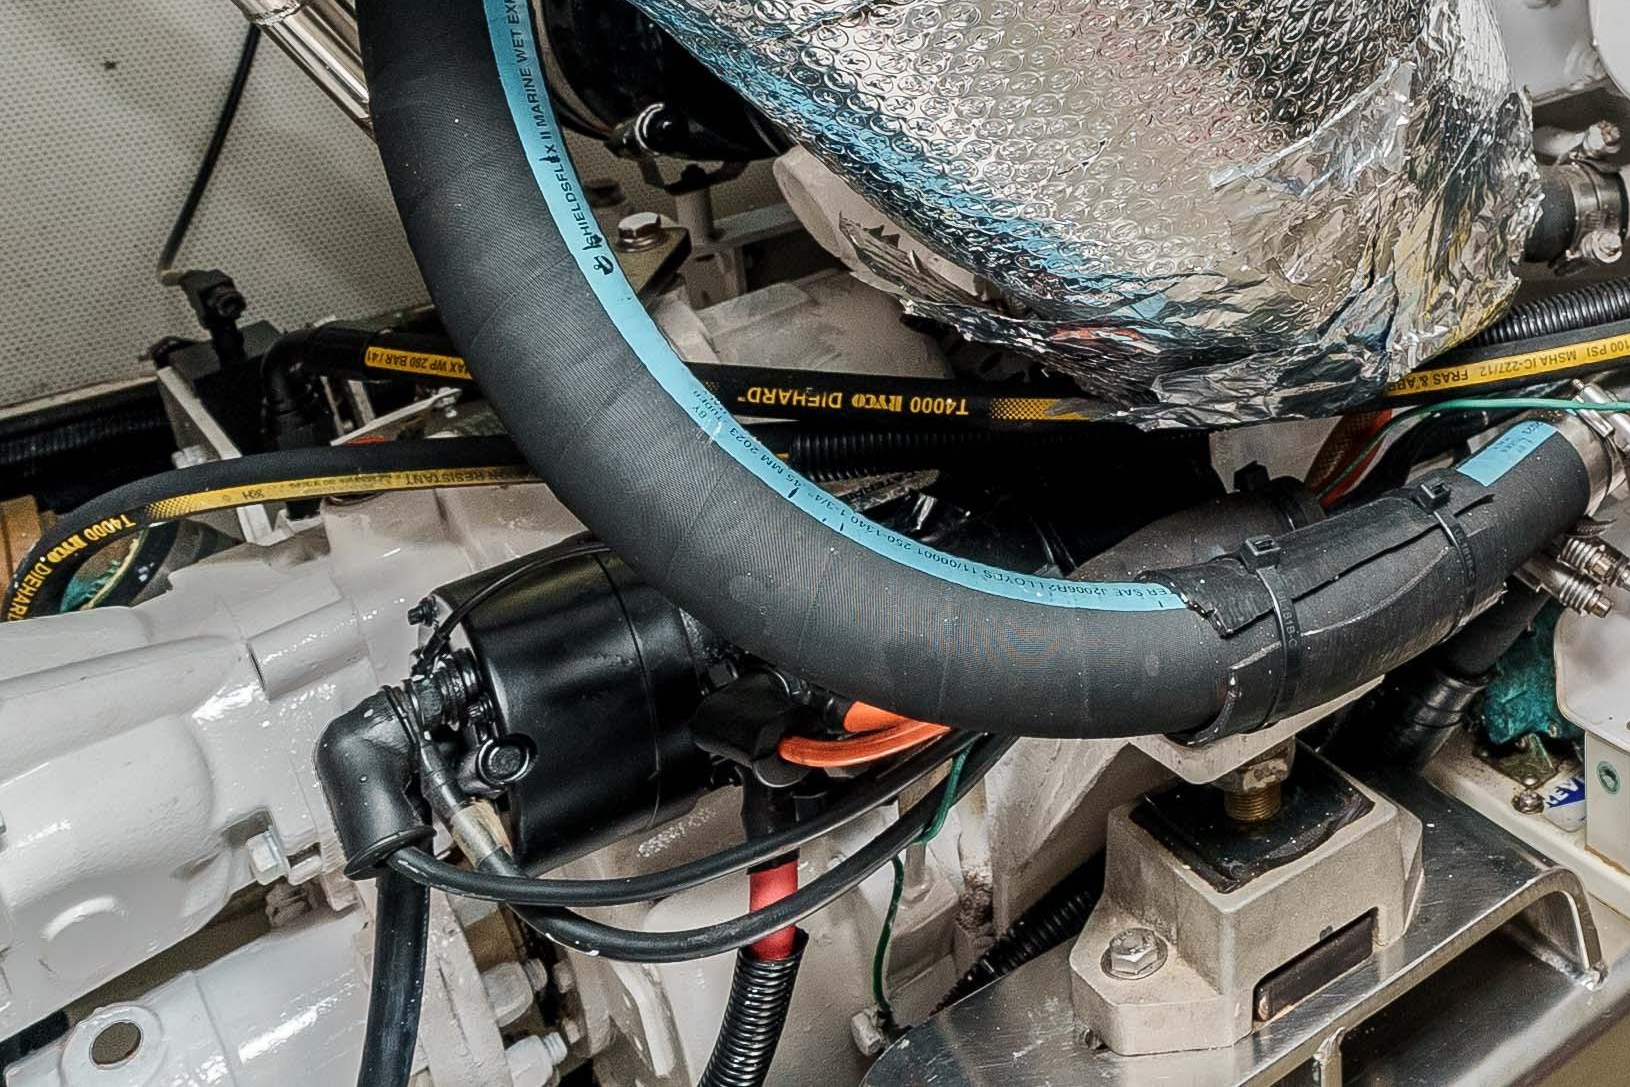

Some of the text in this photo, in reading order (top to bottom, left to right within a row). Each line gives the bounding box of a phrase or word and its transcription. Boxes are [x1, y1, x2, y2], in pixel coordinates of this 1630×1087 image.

[510, 28, 529, 64] WET
[519, 68, 546, 128] MARINE
[1539, 350, 1577, 366] MSHA
[1586, 344, 1608, 359] PSI
[1433, 369, 1469, 386] FRAS
[851, 393, 903, 412] RYCO
[910, 397, 969, 415] T4000
[84, 514, 137, 541] T4000
